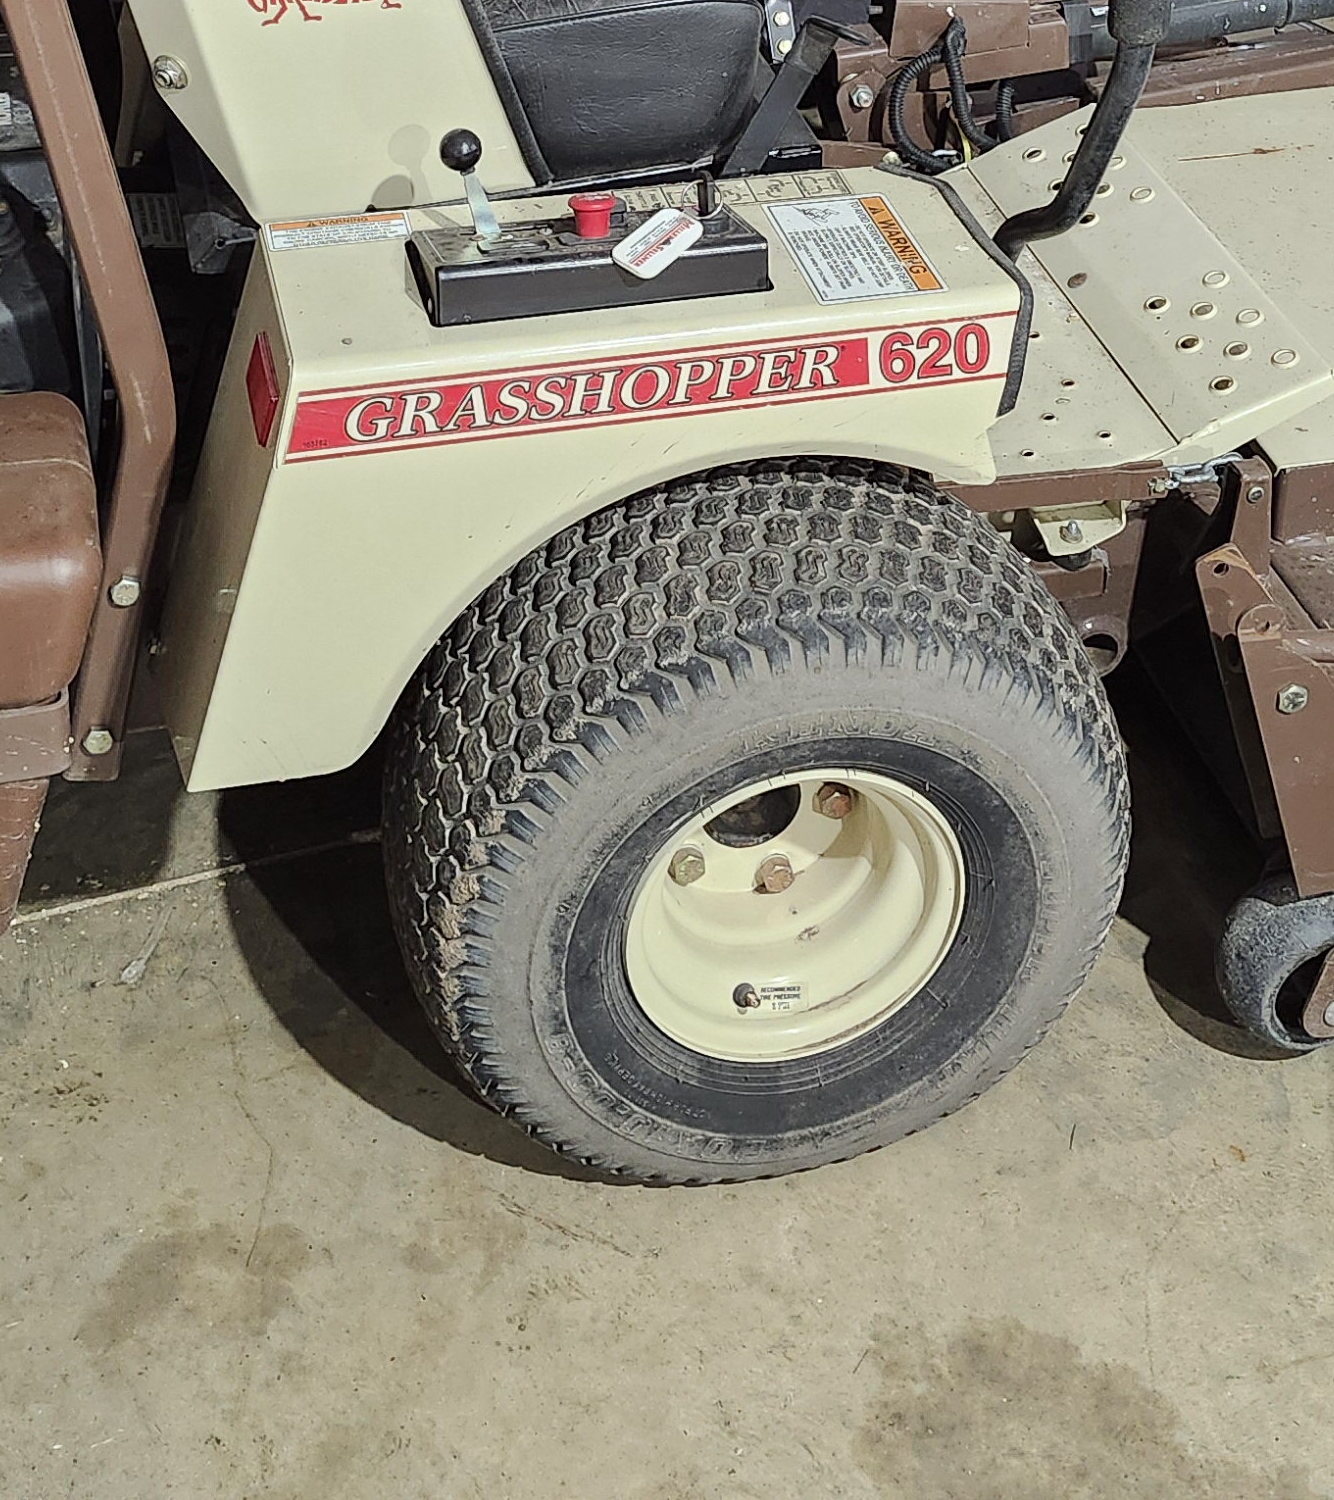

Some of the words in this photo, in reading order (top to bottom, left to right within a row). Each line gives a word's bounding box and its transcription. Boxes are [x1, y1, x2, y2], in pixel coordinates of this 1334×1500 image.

[319, 216, 369, 227] WARNING
[874, 218, 929, 274] WARNING
[877, 245, 898, 263] INJURY
[895, 272, 916, 290] DEATH
[343, 344, 840, 443] GRASSHOPPER
[879, 323, 990, 384] 620
